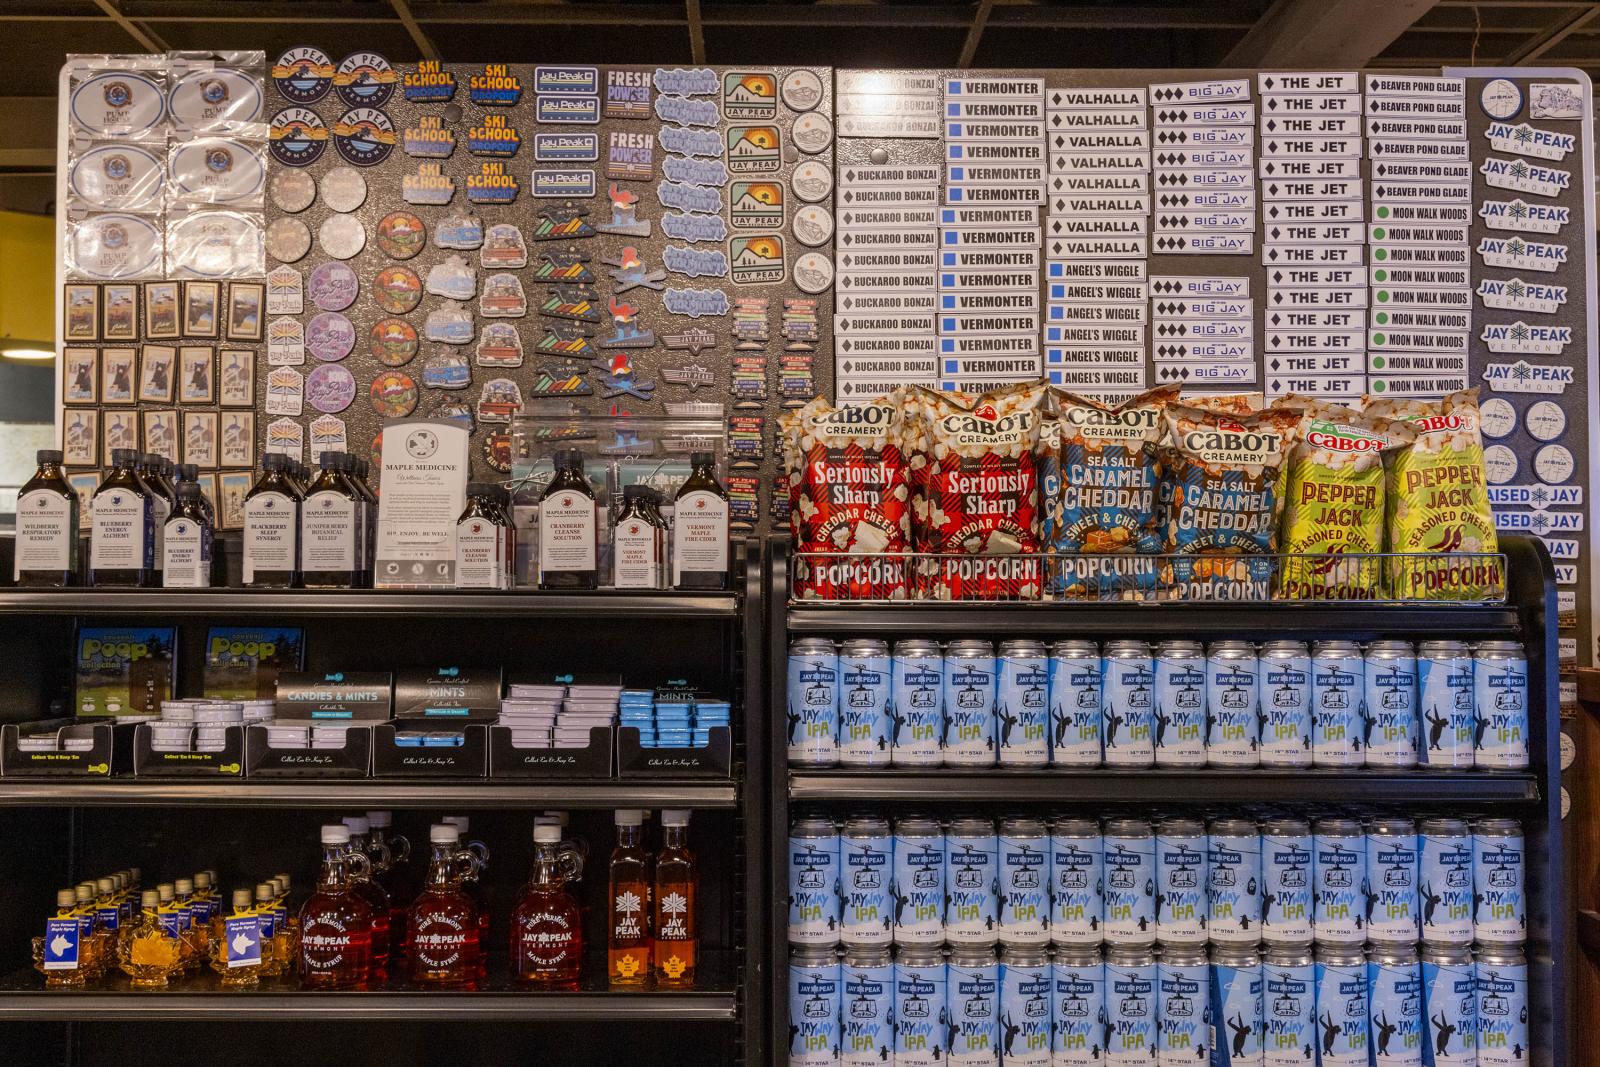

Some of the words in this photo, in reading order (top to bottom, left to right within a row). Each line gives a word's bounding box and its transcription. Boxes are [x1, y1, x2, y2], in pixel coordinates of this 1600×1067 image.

[280, 50, 296, 68] JAY
[302, 49, 328, 69] PEAK
[486, 65, 505, 76] SKI
[540, 72, 556, 80] Jay
[560, 72, 583, 80] Peak
[470, 77, 520, 89] SCHOOL
[608, 71, 650, 87] FRESH
[1281, 78, 1310, 88] THE
[1317, 78, 1342, 88] JET
[284, 80, 325, 97] VERMONT
[966, 82, 1038, 94] VERMONTER
[1189, 88, 1211, 96] BIG
[1217, 86, 1241, 94] JAY
[1381, 81, 1410, 90] BEAVER
[1413, 82, 1434, 91] POND
[1437, 83, 1461, 92] GLADE
[472, 92, 516, 100] DROPOUT
[1066, 94, 1139, 105] VALHALLA
[541, 139, 556, 147] Jay
[1069, 136, 1142, 147] VALHALLA
[1488, 125, 1513, 139] JAY
[1534, 132, 1573, 149] PEAK
[1385, 145, 1414, 153] BEAVER
[1417, 145, 1438, 154] POND
[1441, 146, 1465, 155] GLADE
[1493, 140, 1564, 158] VERMONT
[858, 170, 904, 181] BUCKAROO
[906, 170, 937, 181] BONZAI
[1393, 208, 1414, 219] MOON
[1417, 208, 1439, 219] WALK
[1440, 209, 1467, 220] WOODS
[962, 232, 1035, 243] VERMONTER
[1067, 242, 1140, 254] VALHALLA
[1285, 250, 1315, 260] THE
[1322, 249, 1348, 260] JET
[1066, 265, 1102, 277] ANGEL'S
[1104, 264, 1139, 277] WIGGLE
[852, 319, 898, 330] BUCKAROO
[901, 319, 932, 330] BONZAI
[961, 318, 1033, 330] VERMONTER
[1065, 350, 1101, 362] ANGEL'S
[1103, 350, 1138, 362] WIGGLE
[964, 360, 1036, 372] VERMONTER
[1287, 359, 1316, 370] THE
[1322, 358, 1349, 370] JET
[1487, 366, 1510, 380] JAY
[1532, 367, 1572, 381] PEAK
[1389, 381, 1412, 392] MOON
[1414, 380, 1436, 391] WALK
[1438, 379, 1463, 390] WOODS
[1492, 381, 1564, 391] VERMONT
[960, 434, 1017, 443] CREAMERY
[1084, 428, 1143, 437] CREAMERY
[1088, 457, 1107, 466] SEA
[1111, 458, 1136, 467] SALT
[1204, 453, 1263, 462] CREAMERY
[815, 461, 894, 488] Seriously
[1072, 465, 1151, 487] CARAMEL
[1407, 466, 1482, 493] PEPPER
[949, 469, 1029, 496] Seriously
[1207, 480, 1230, 490] SEA
[1230, 481, 1256, 492] SALT
[834, 482, 879, 508] Sharp
[1064, 486, 1153, 513] CHEDDAR
[1188, 485, 1270, 511] CARAMEL
[1302, 482, 1376, 509] PEPPER
[1426, 489, 1474, 509] JACK
[1487, 489, 1529, 501] AISED
[1550, 490, 1578, 501] JAY
[967, 496, 1016, 517] Sharp
[1179, 508, 1271, 532] CHEDDAR
[1315, 509, 1362, 526] JACK
[817, 508, 859, 542] CHEDDAR
[864, 509, 898, 540] CHEESE
[1066, 514, 1098, 539] SWEET
[1103, 513, 1110, 523] &
[1409, 511, 1456, 547] SEASONED
[1460, 512, 1491, 540] CHEESE
[947, 520, 992, 548] CHEDDAR
[998, 520, 1029, 542] CHEESE
[817, 560, 904, 586] POPCORN
[947, 560, 1036, 580] POPCORN
[1062, 558, 1153, 579] POPCORN
[1411, 566, 1499, 591] POPCORN
[1178, 581, 1267, 600] POPCORN
[81, 638, 148, 661] Poop
[288, 692, 331, 700] CANDIES
[346, 692, 377, 700] MINTS
[430, 689, 465, 697] MINTS
[794, 855, 807, 864] JAY
[813, 855, 828, 864] PEAK
[419, 919, 431, 932] PURE
[434, 917, 462, 931] VERMONT
[620, 918, 635, 926] JAY
[442, 934, 465, 943] PEAK
[419, 953, 438, 966] MAPLE
[440, 953, 459, 966] SYRUP
